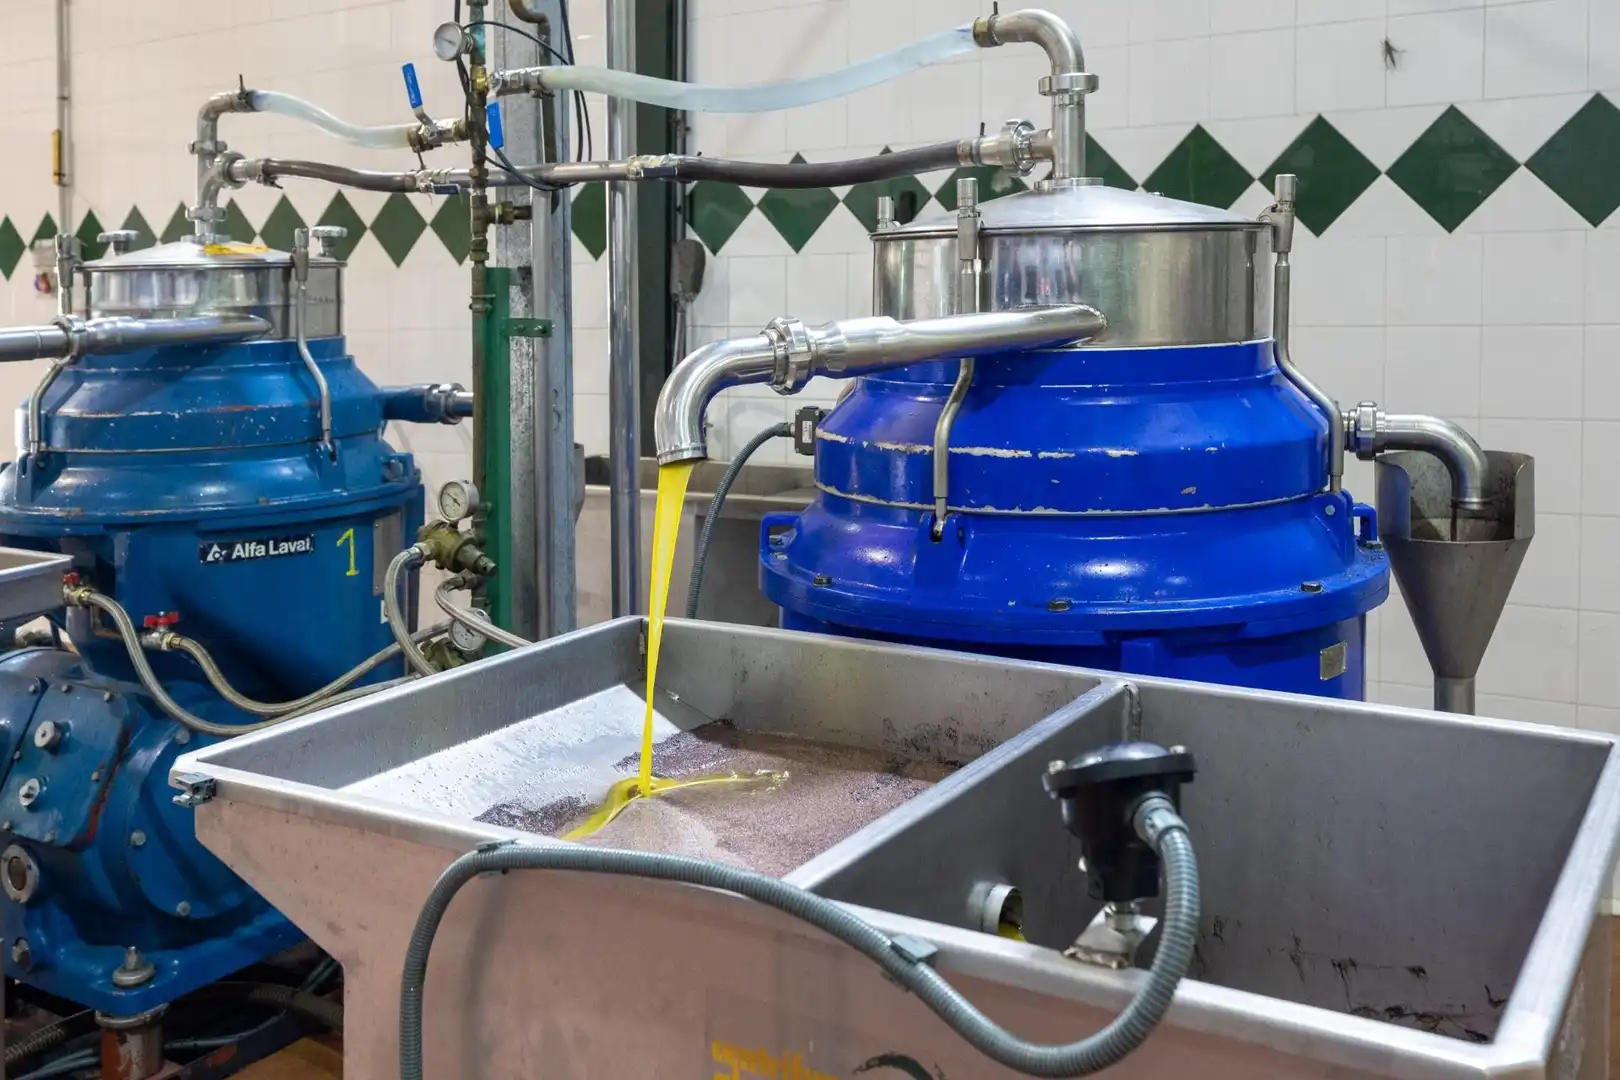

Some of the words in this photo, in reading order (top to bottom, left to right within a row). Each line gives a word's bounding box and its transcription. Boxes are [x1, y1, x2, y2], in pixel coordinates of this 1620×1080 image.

[231, 541, 266, 559] Alfa
[268, 537, 310, 555] Laval
[336, 528, 359, 576] 1
